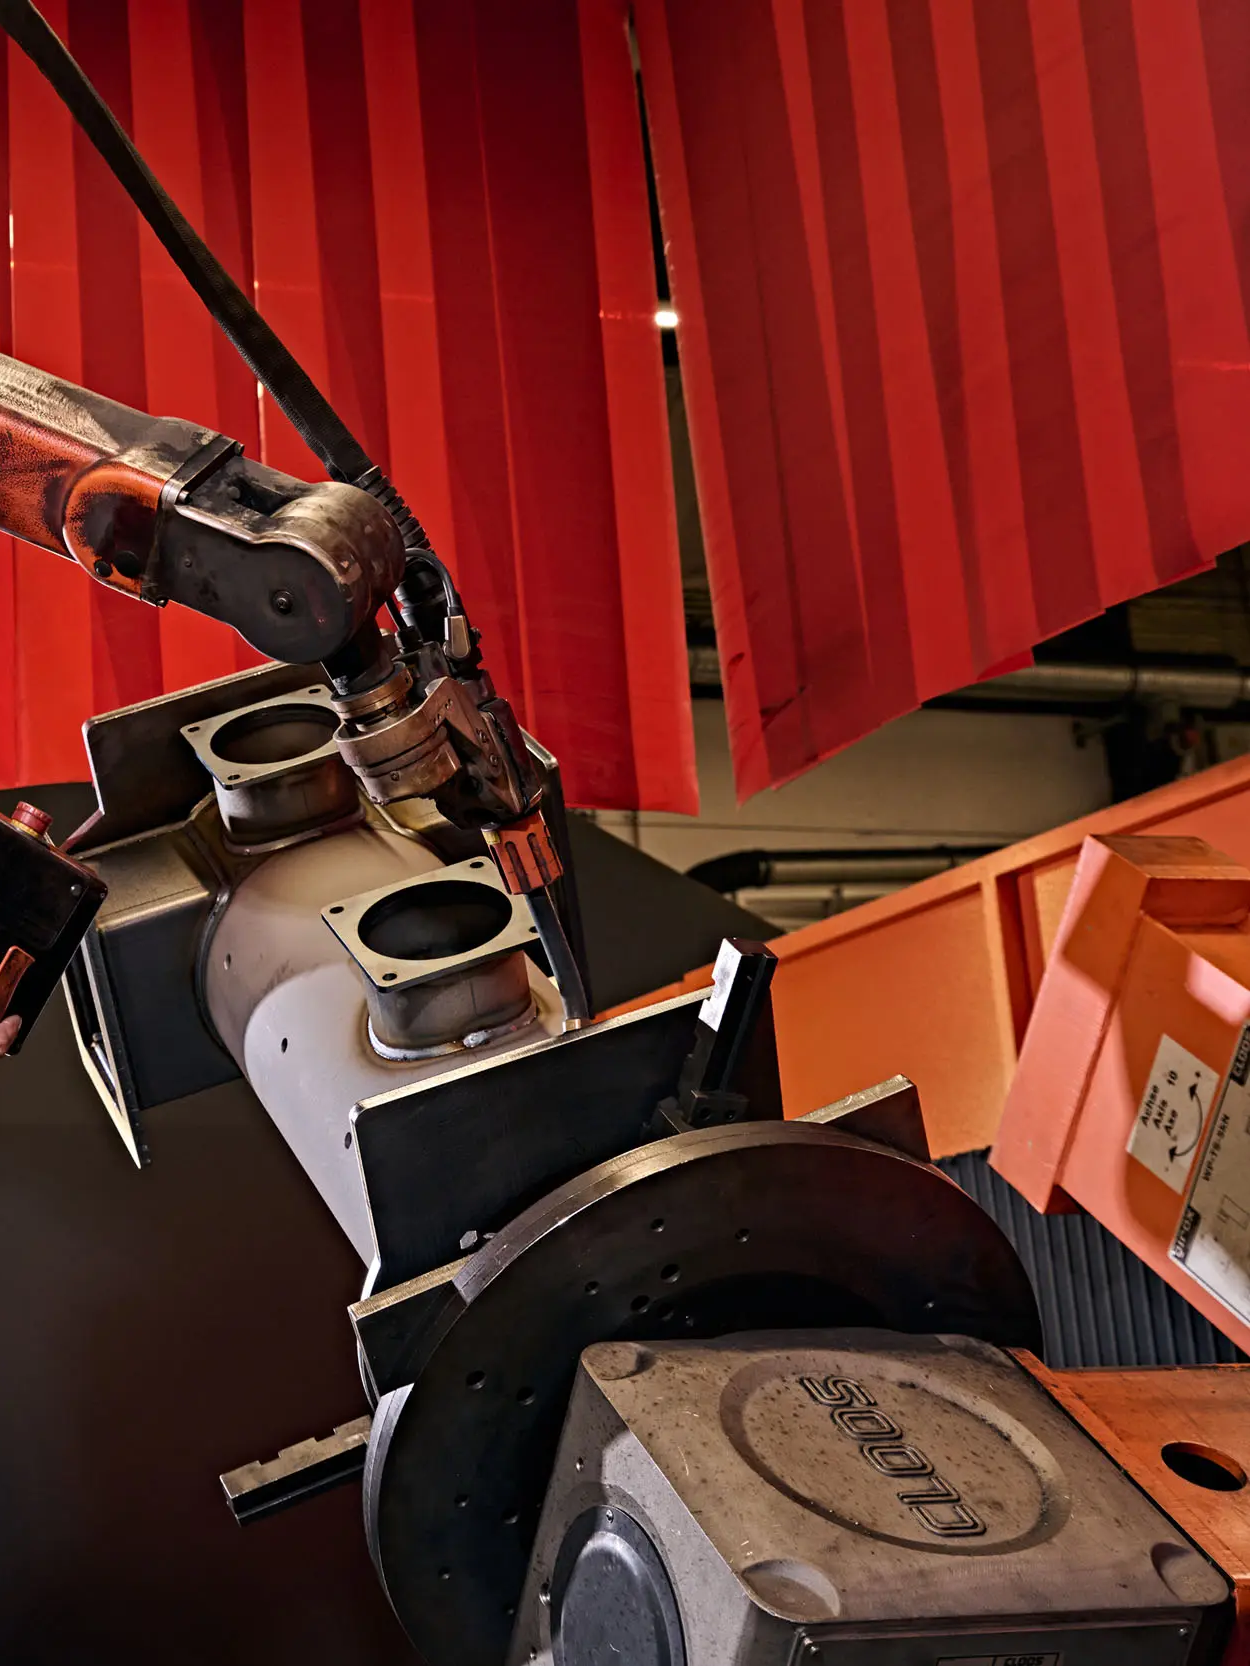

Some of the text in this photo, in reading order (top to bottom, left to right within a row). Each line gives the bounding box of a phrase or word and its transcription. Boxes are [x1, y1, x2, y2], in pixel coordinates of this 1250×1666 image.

[1140, 1085, 1159, 1128] Achse
[1152, 1070, 1179, 1130] Axis 10
[1162, 1109, 1178, 1137] Axe
[800, 1375, 987, 1538] CLOOS
